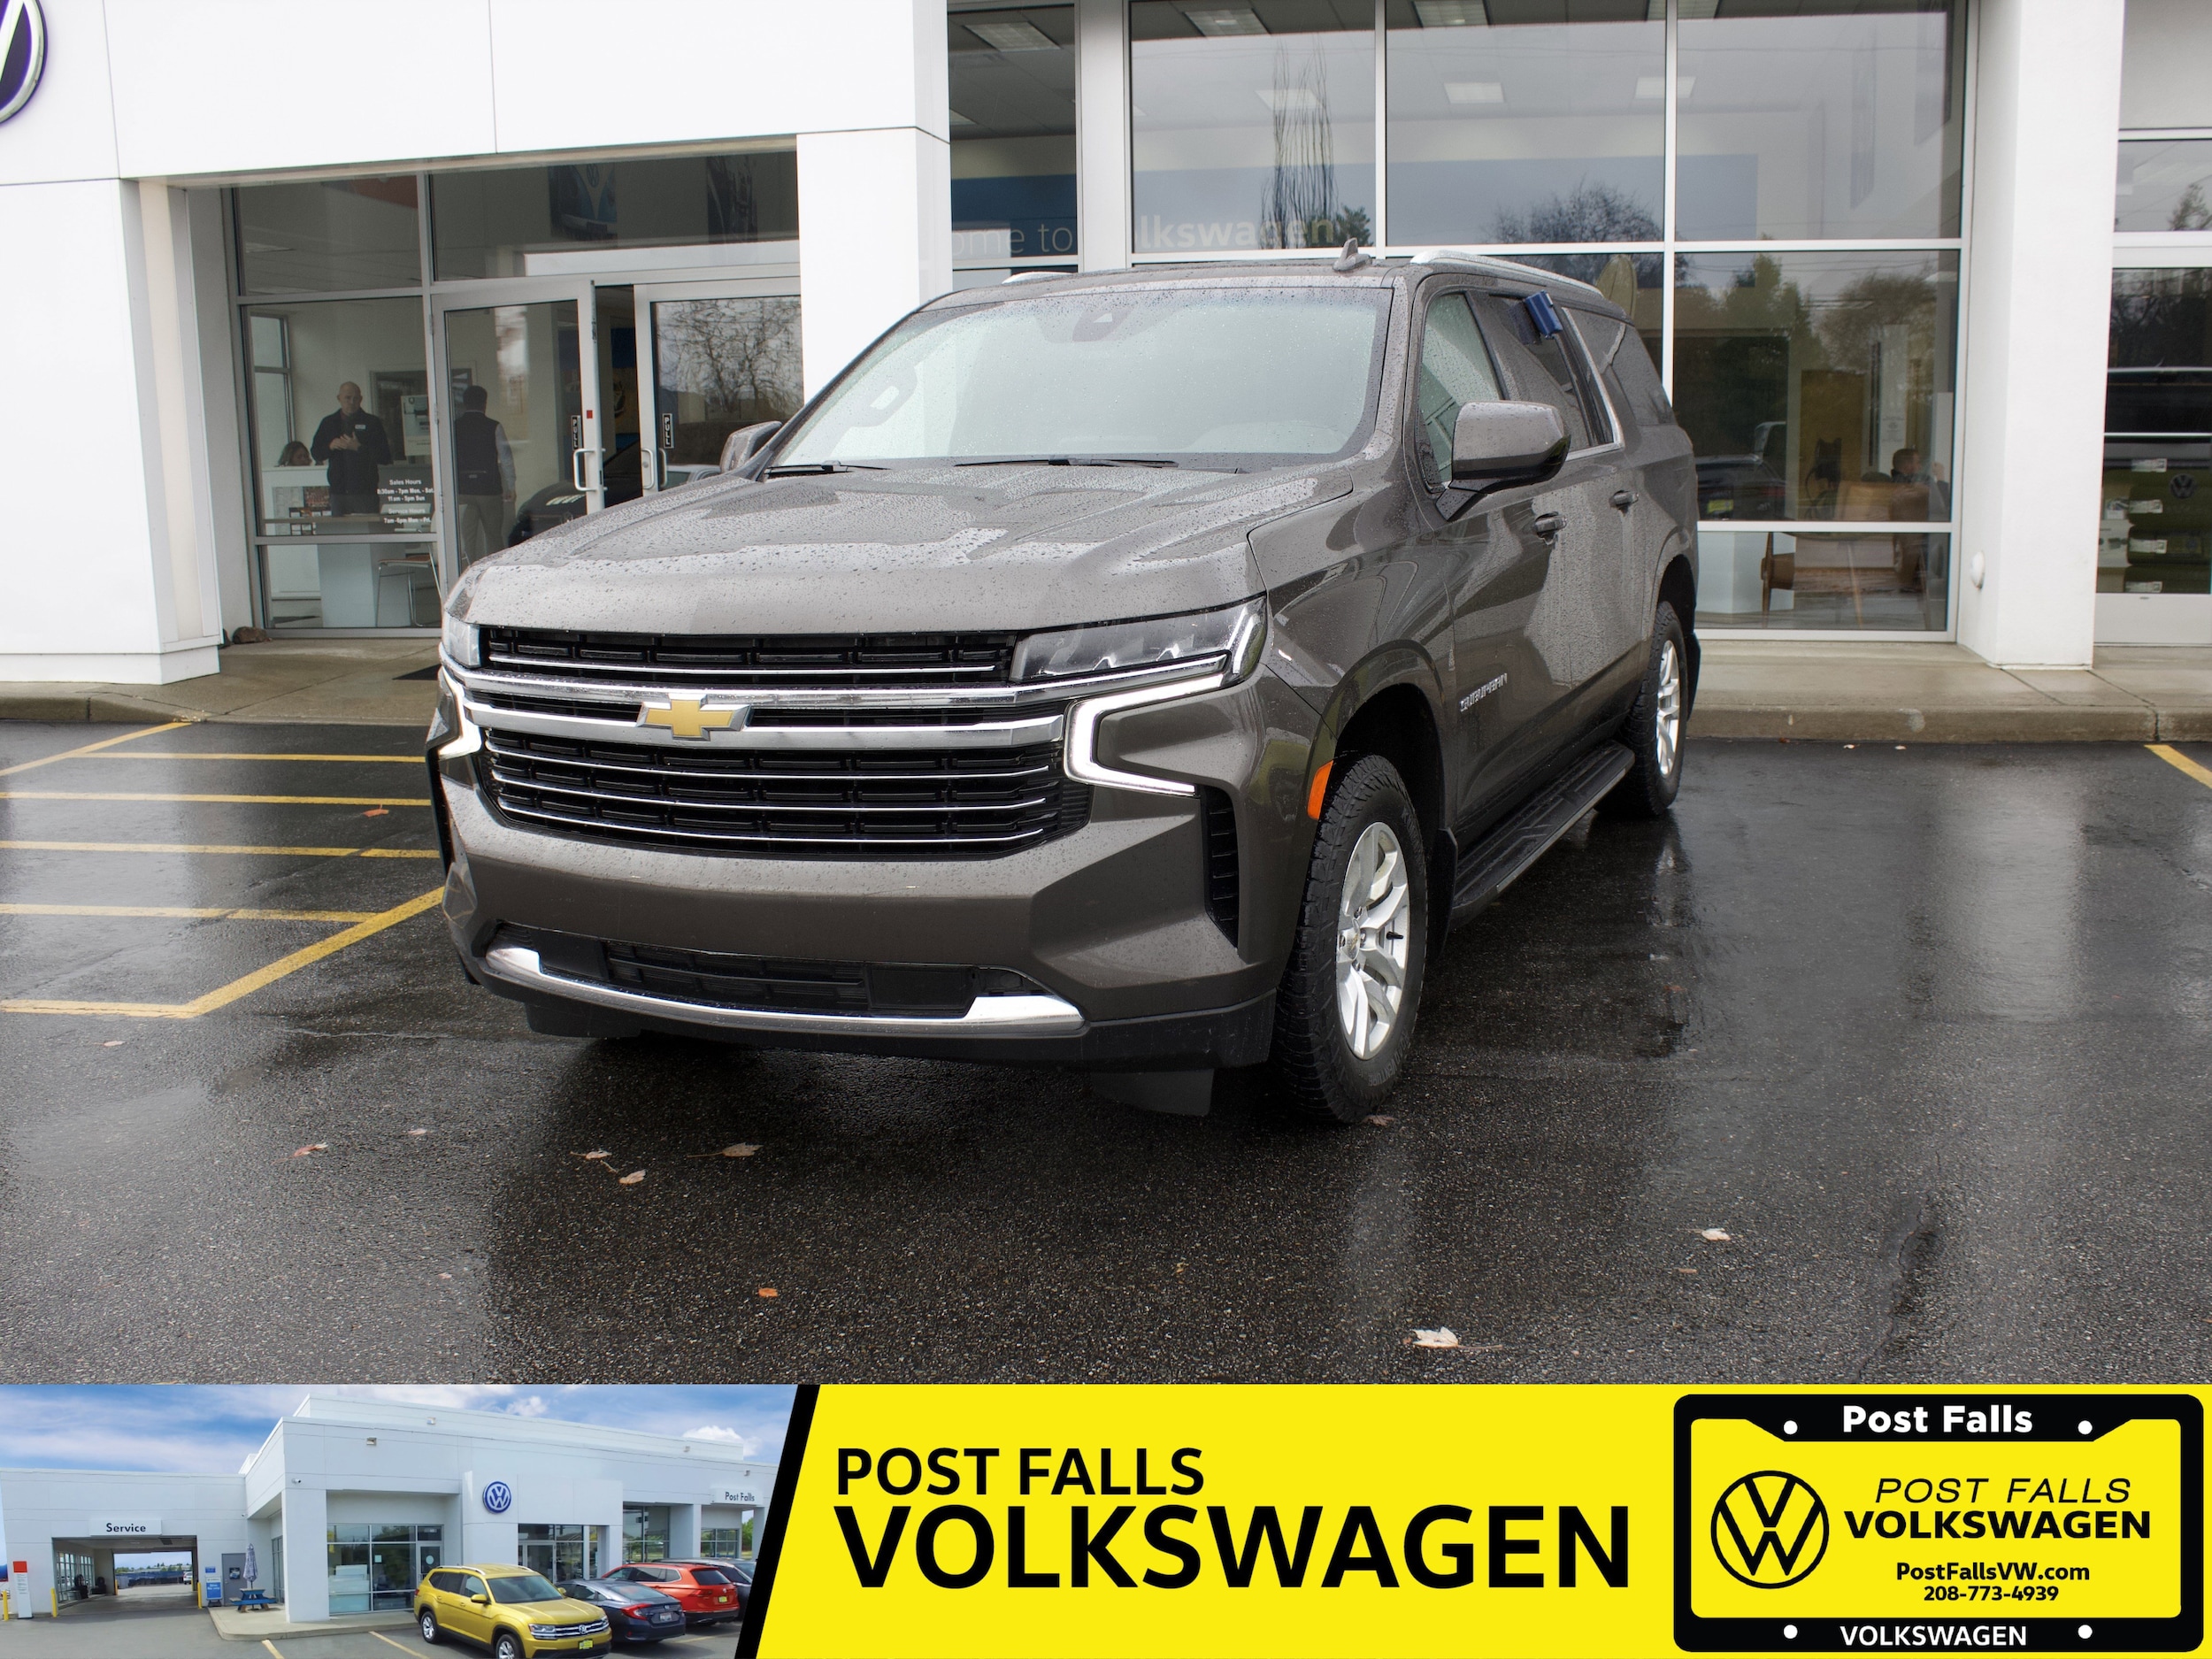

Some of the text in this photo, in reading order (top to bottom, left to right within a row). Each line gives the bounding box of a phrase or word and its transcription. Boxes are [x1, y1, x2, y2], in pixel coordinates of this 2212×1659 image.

[1038, 223, 1073, 253] to
[1135, 214, 1334, 249] lkswagen
[1460, 672, 1508, 712] SUBURBAN
